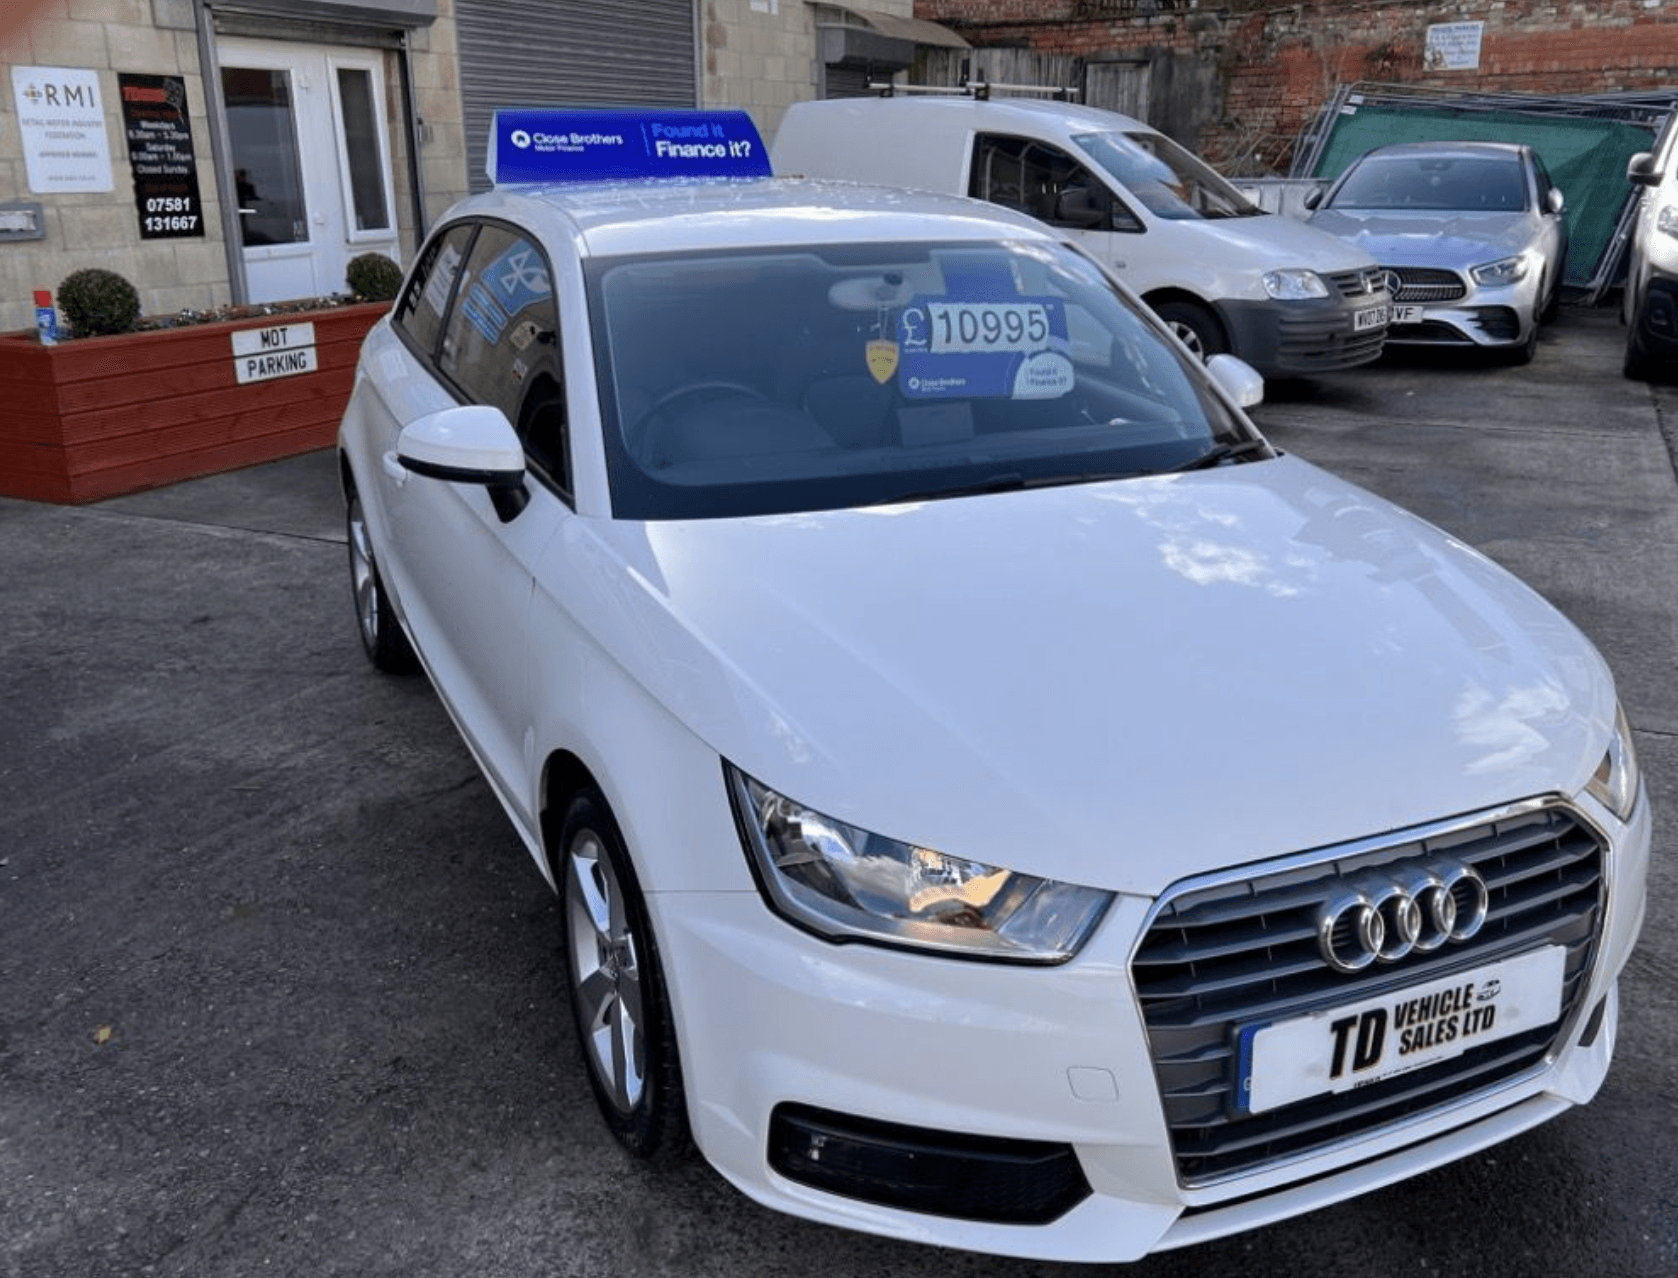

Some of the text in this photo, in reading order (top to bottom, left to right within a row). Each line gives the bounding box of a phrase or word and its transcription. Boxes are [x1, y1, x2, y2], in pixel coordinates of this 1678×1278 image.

[45, 83, 95, 108] RMI
[569, 132, 623, 145] Brothers
[655, 139, 752, 158] Finance it?
[146, 197, 191, 212] 07581
[144, 215, 198, 231] 131667
[261, 328, 288, 348] MOT
[938, 309, 1047, 344] 10995
[248, 352, 307, 377] PARKING
[1394, 983, 1474, 1030] VEHICLE
[1398, 1004, 1496, 1056] SALES LTD
[1329, 1007, 1388, 1080] TD
